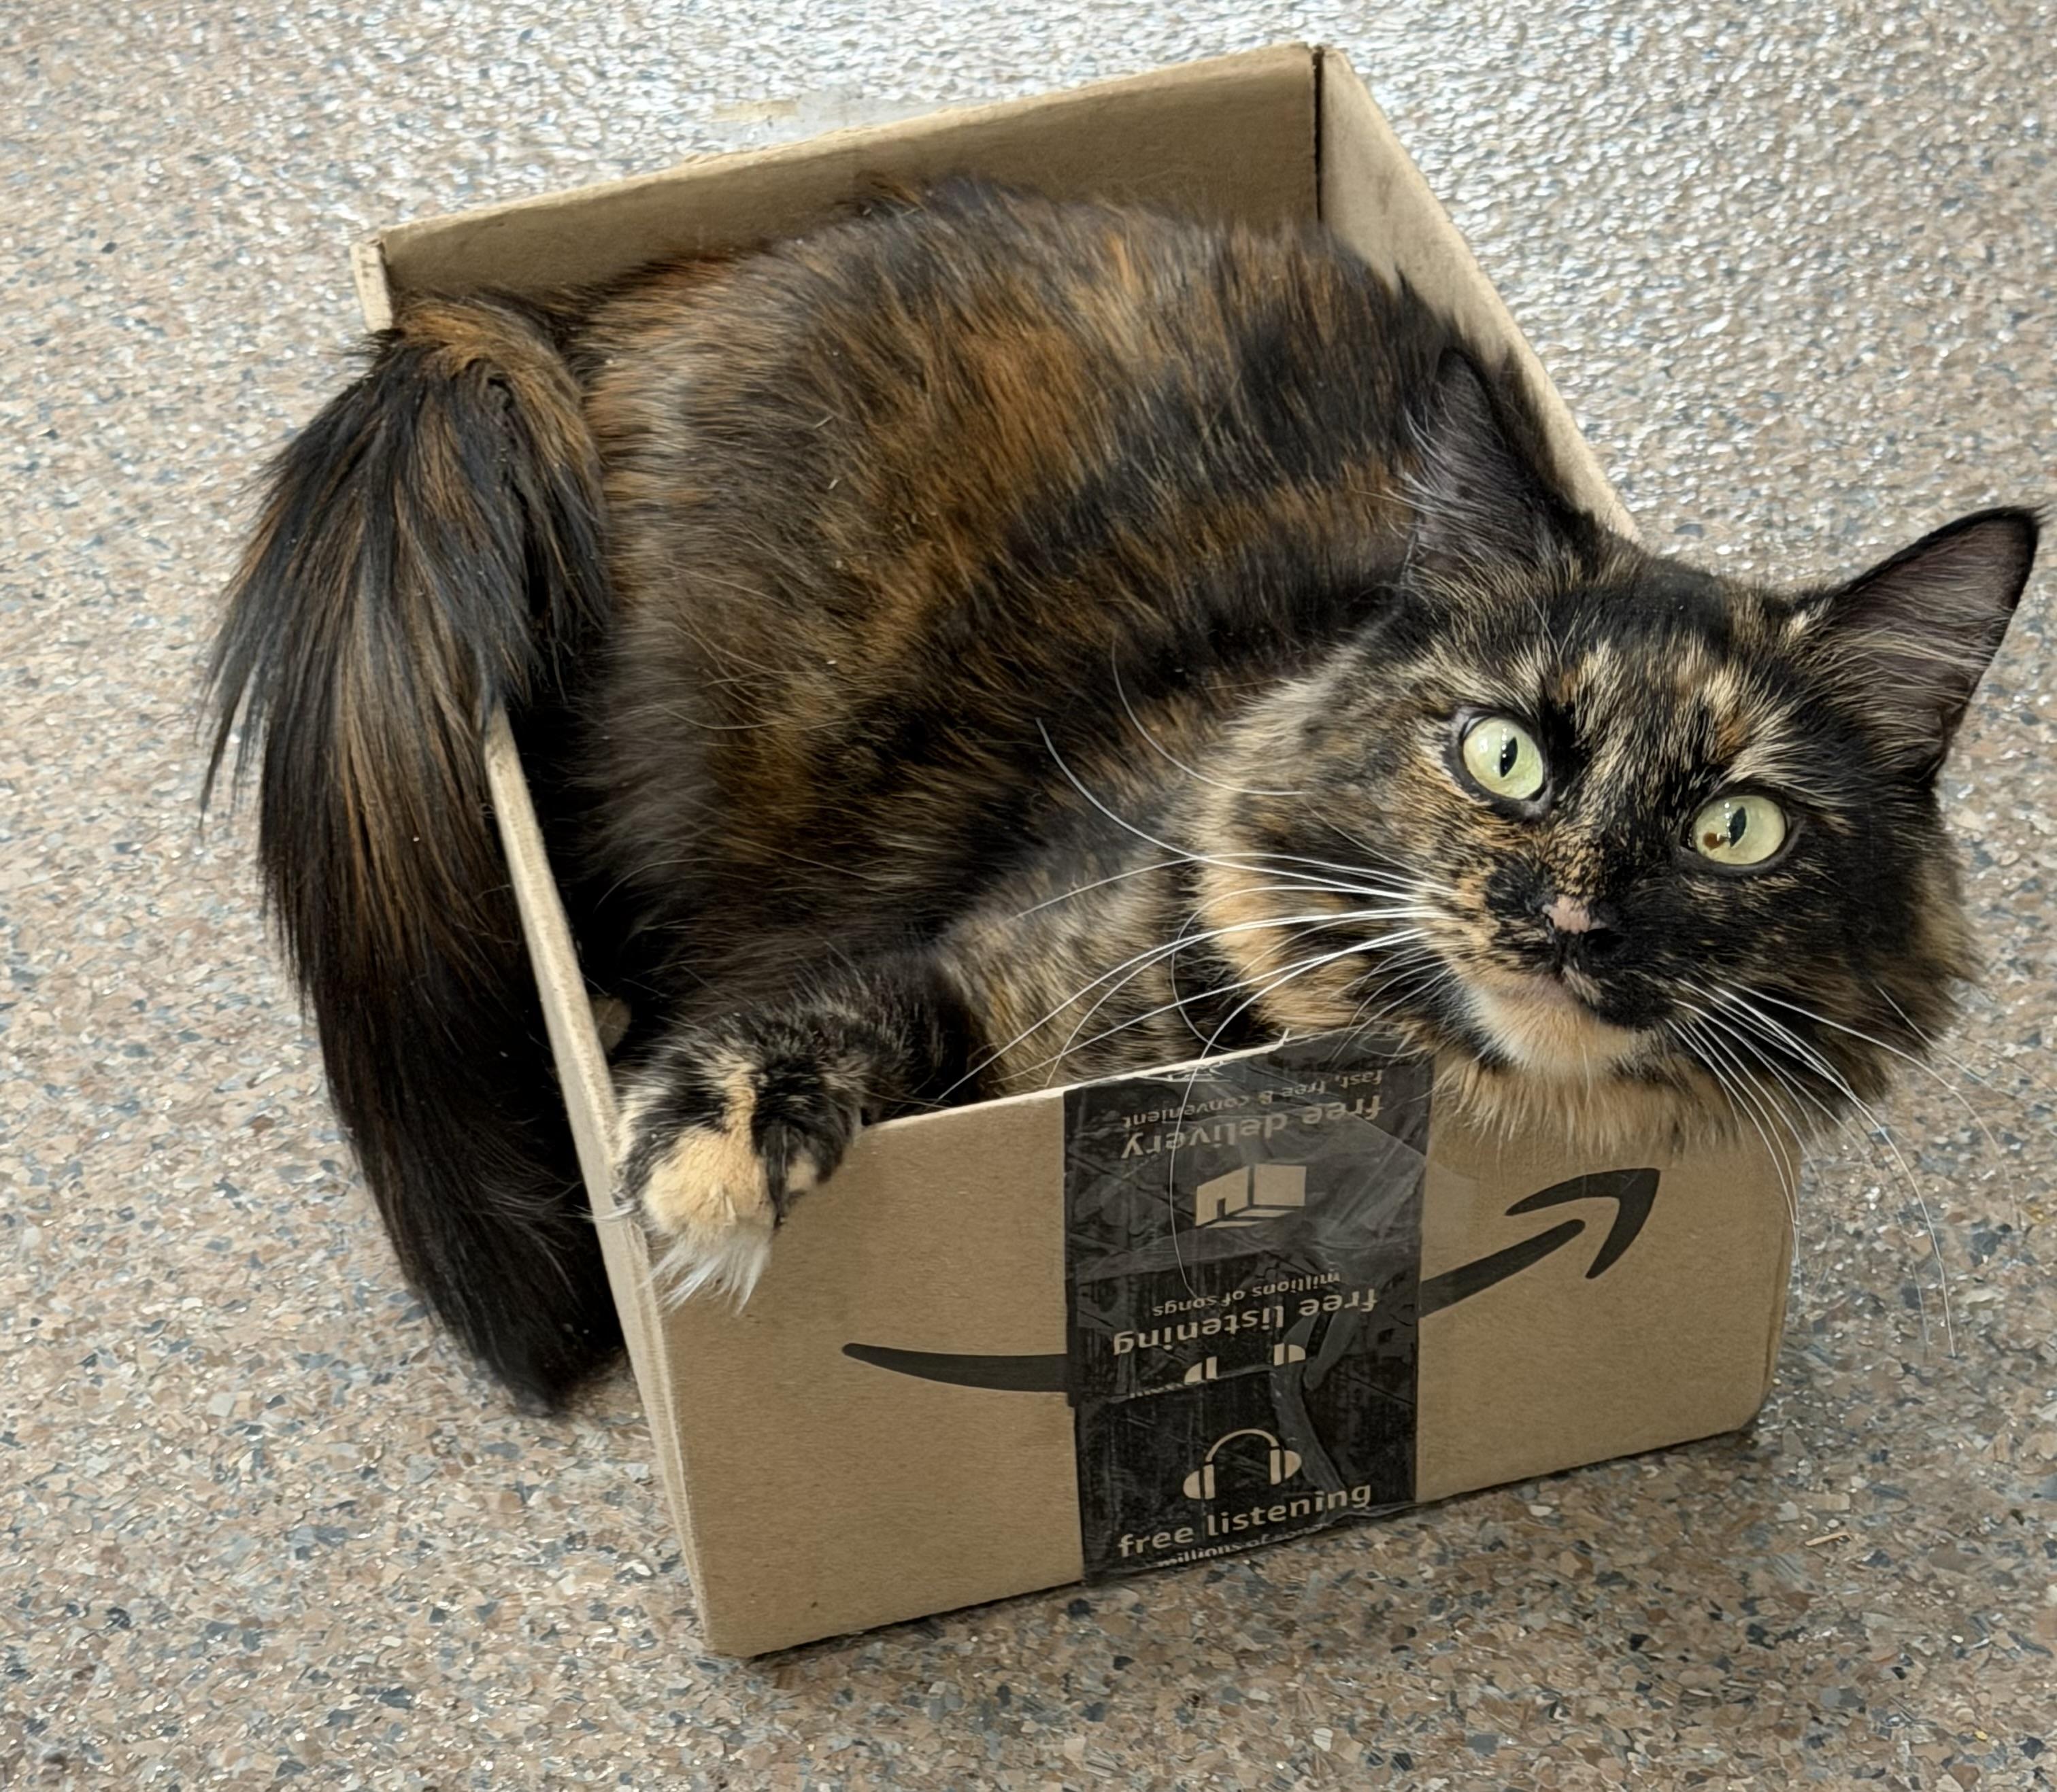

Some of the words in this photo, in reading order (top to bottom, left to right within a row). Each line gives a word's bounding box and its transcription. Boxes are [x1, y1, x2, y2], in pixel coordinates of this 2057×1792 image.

[1282, 1080, 1326, 1094] free
[1122, 1095, 1250, 1129] convenient
[1301, 1095, 1384, 1125] free
[1121, 1113, 1288, 1159] delivery
[1223, 1289, 1245, 1305] of
[1251, 1272, 1340, 1298] millions
[1152, 1296, 1219, 1317] songs
[1299, 1289, 1379, 1317] free
[1113, 1305, 1284, 1356] listening
[1118, 1526, 1194, 1558] free
[1206, 1484, 1371, 1537] listening
